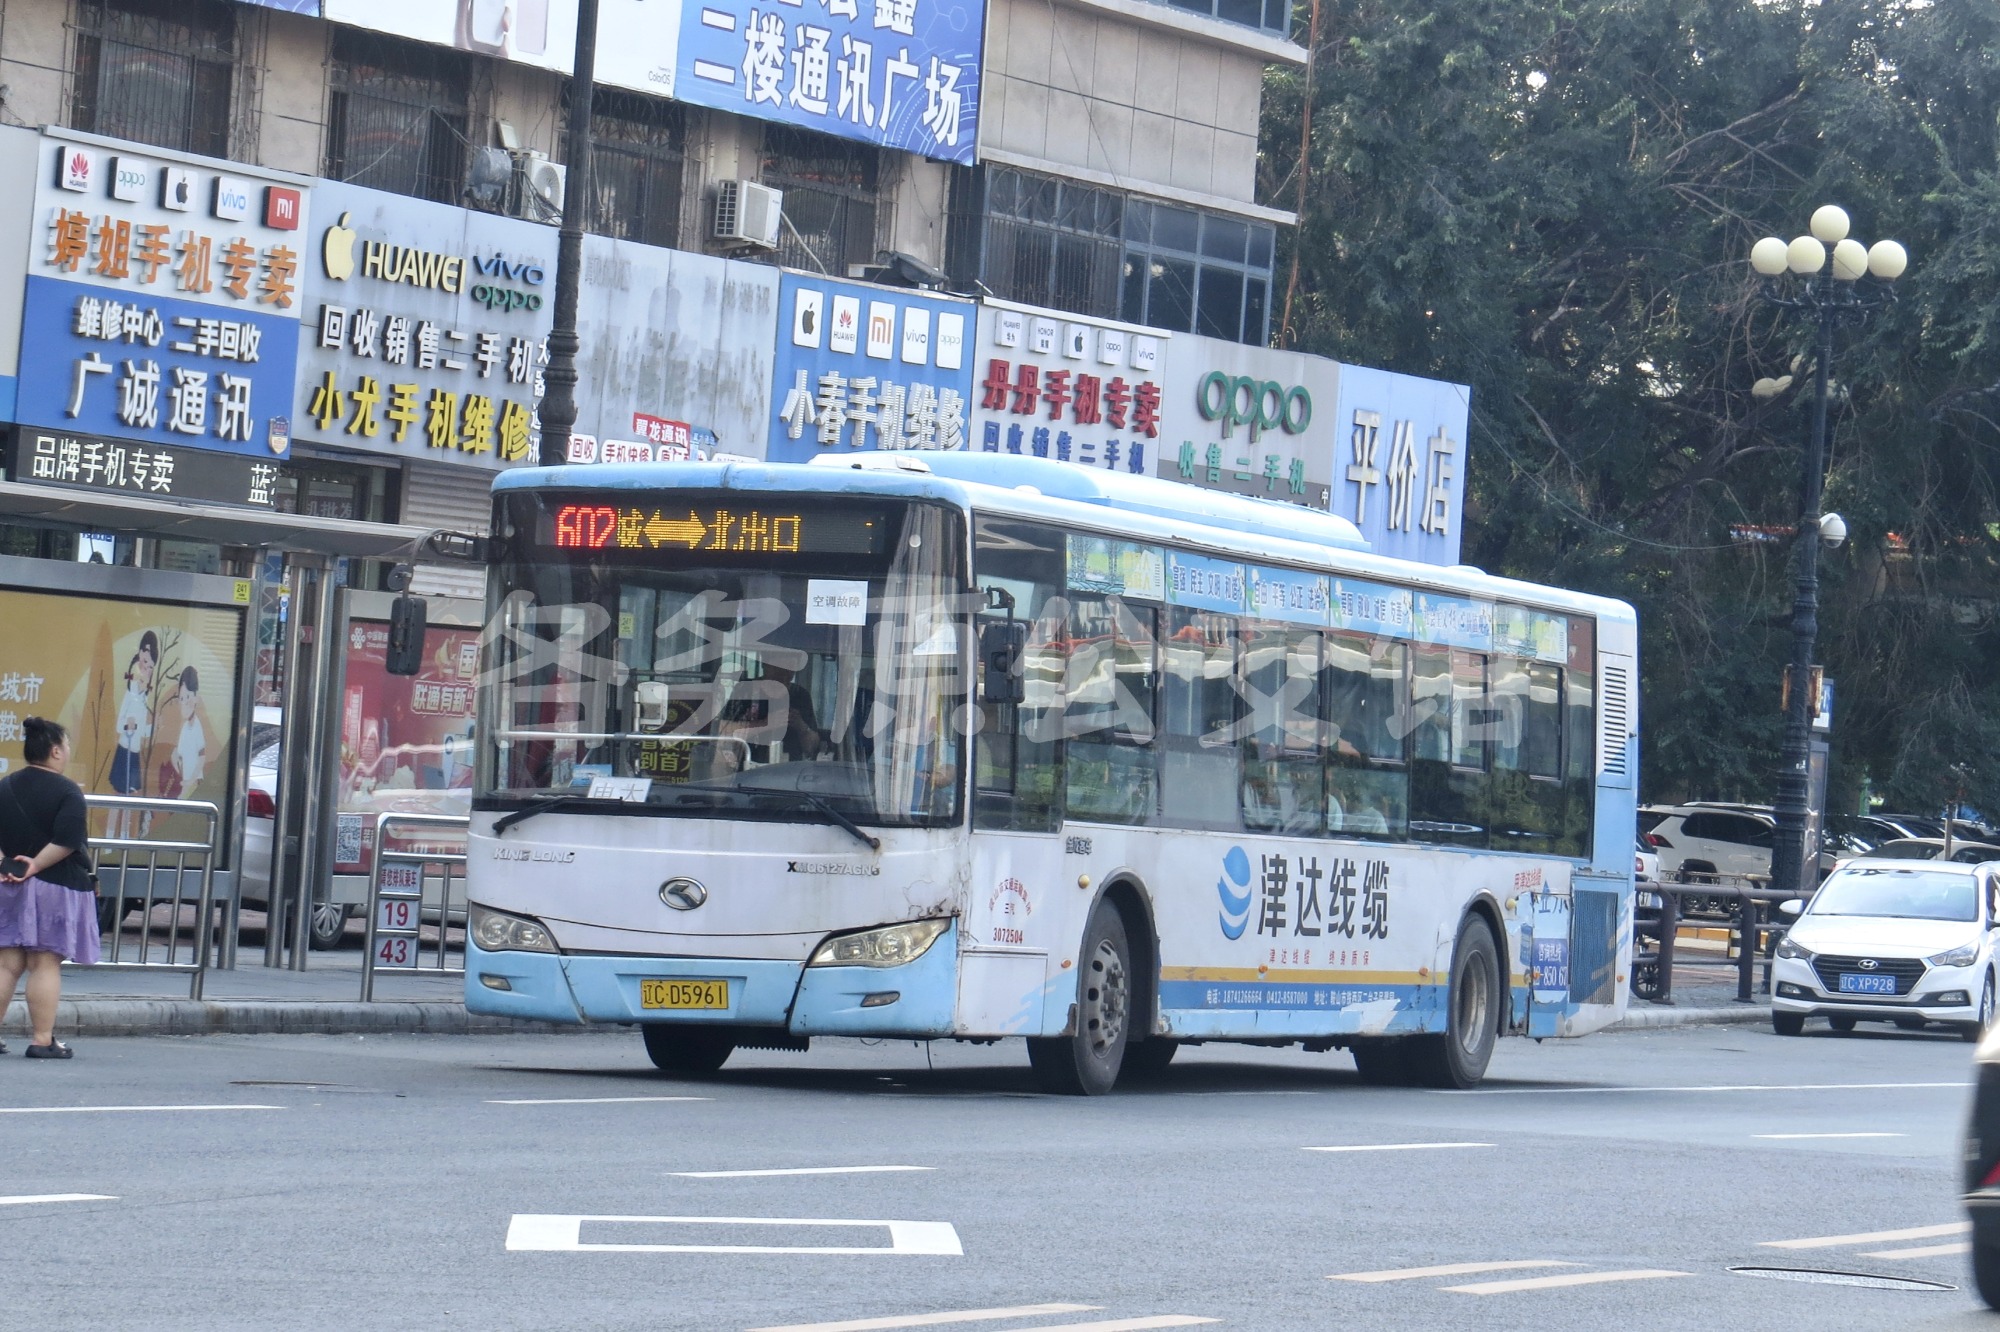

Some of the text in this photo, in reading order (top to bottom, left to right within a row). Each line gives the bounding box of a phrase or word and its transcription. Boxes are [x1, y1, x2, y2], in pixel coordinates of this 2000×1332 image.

[694, 9, 963, 146] 二楼通讯广场
[221, 189, 246, 210] vivo
[50, 207, 297, 308] 婷姐手机专卖
[363, 240, 467, 294] HUAWEI
[473, 252, 546, 285] vivo
[471, 284, 543, 313] oppo
[77, 296, 262, 363] 维修中心 二手回收
[318, 304, 534, 384] 回收销售二手机
[833, 331, 856, 343] HUAWEI
[905, 328, 927, 344] vivo
[1138, 350, 1155, 361] vivo
[66, 352, 253, 442] 广诚通讯
[309, 371, 531, 462] 小尤手机维修
[779, 369, 965, 451] 小春手机维修
[981, 358, 1161, 438] 丹丹手机专卖
[1199, 370, 1312, 443] oppo
[605, 444, 650, 462] 手机快修
[635, 418, 689, 448] 翼龙通讯
[983, 420, 1145, 474] 回收销售二手机
[33, 435, 175, 493] 品牌手机专卖
[248, 463, 276, 506] 蓝
[1178, 440, 1306, 495] 收售二手机
[1345, 408, 1456, 536] 平价店
[557, 506, 615, 547] 602
[705, 509, 802, 552] 北出口
[812, 594, 860, 609] 空调故障
[1190, 567, 1204, 595] 民主
[1207, 572, 1221, 598] 文明
[0, 671, 44, 705] 城市
[413, 683, 477, 713] 联通有新“
[532, 849, 577, 864] LONG
[385, 902, 408, 926] 19
[1257, 853, 1390, 940] 津达线缆
[380, 939, 407, 963] 43
[993, 927, 1023, 943] 3072504
